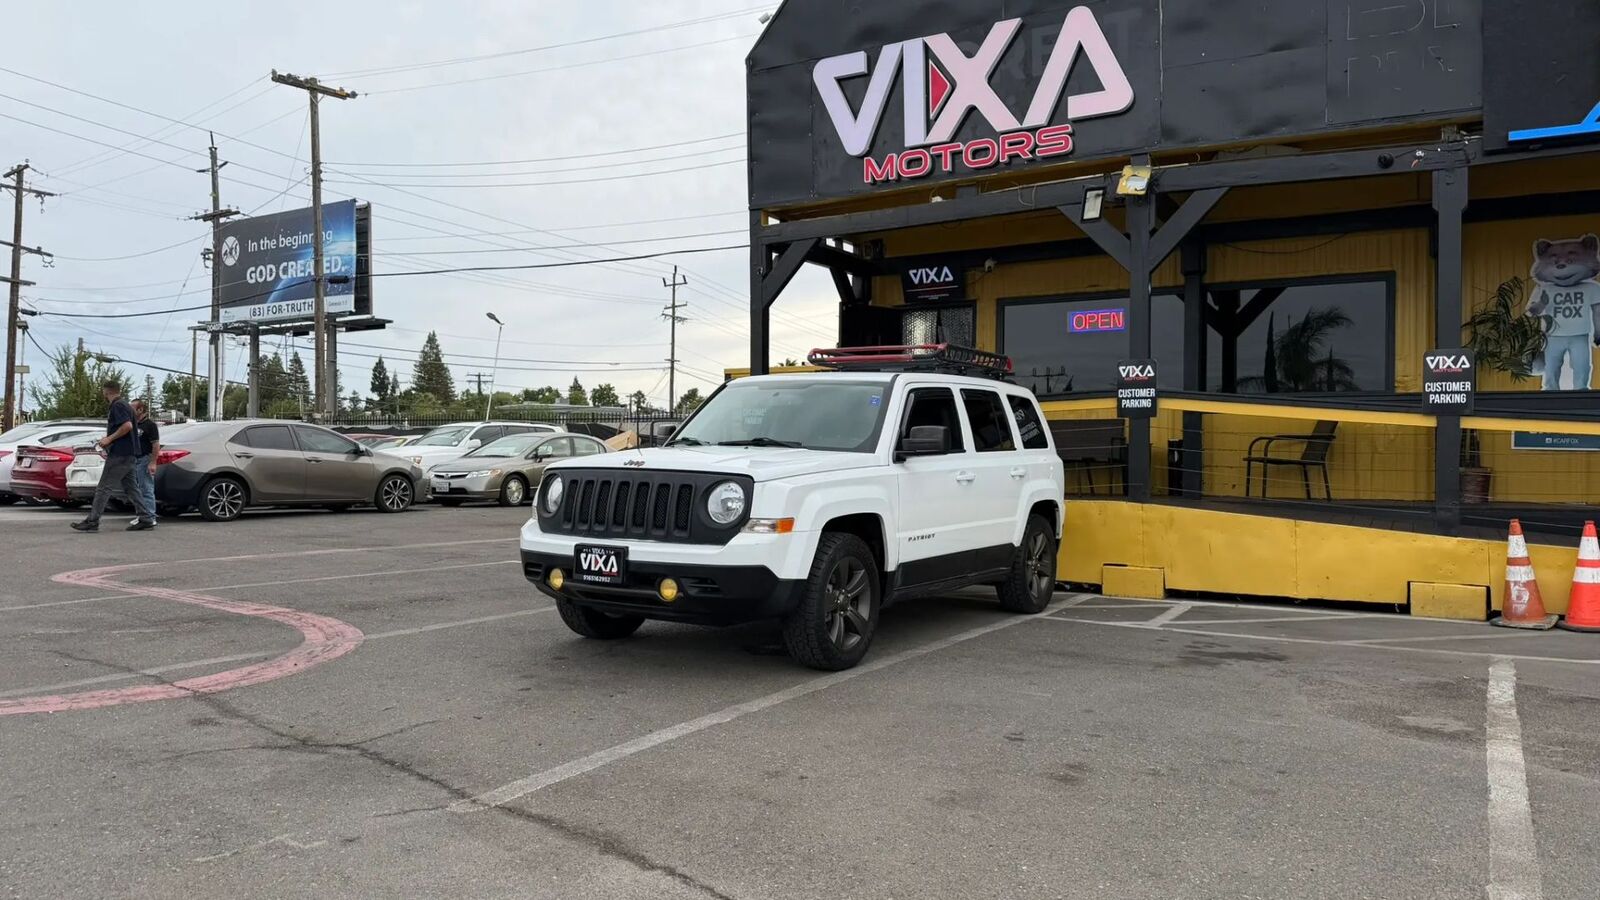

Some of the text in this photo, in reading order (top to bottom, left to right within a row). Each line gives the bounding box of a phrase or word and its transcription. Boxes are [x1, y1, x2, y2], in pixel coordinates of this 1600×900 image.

[812, 5, 1135, 157] VIXA
[863, 124, 1073, 184] MOTORS
[248, 239, 258, 252] In
[260, 236, 277, 250] the
[246, 255, 345, 284] GOD CREAED.
[909, 266, 954, 284] VIXA
[1553, 291, 1584, 305] CAR
[249, 306, 265, 318] (83)
[266, 300, 314, 315] FOR-TRUTH
[1553, 306, 1583, 318] FOX
[1073, 312, 1123, 330] OPEN
[1426, 355, 1471, 369] VIXA
[1118, 365, 1155, 377] VIXA
[1118, 388, 1156, 398] CUSTOMER
[1425, 382, 1471, 392] CUSTOMER
[1121, 399, 1152, 408] PARKING
[1429, 393, 1467, 404] PARKING
[580, 552, 618, 573] VIXA
